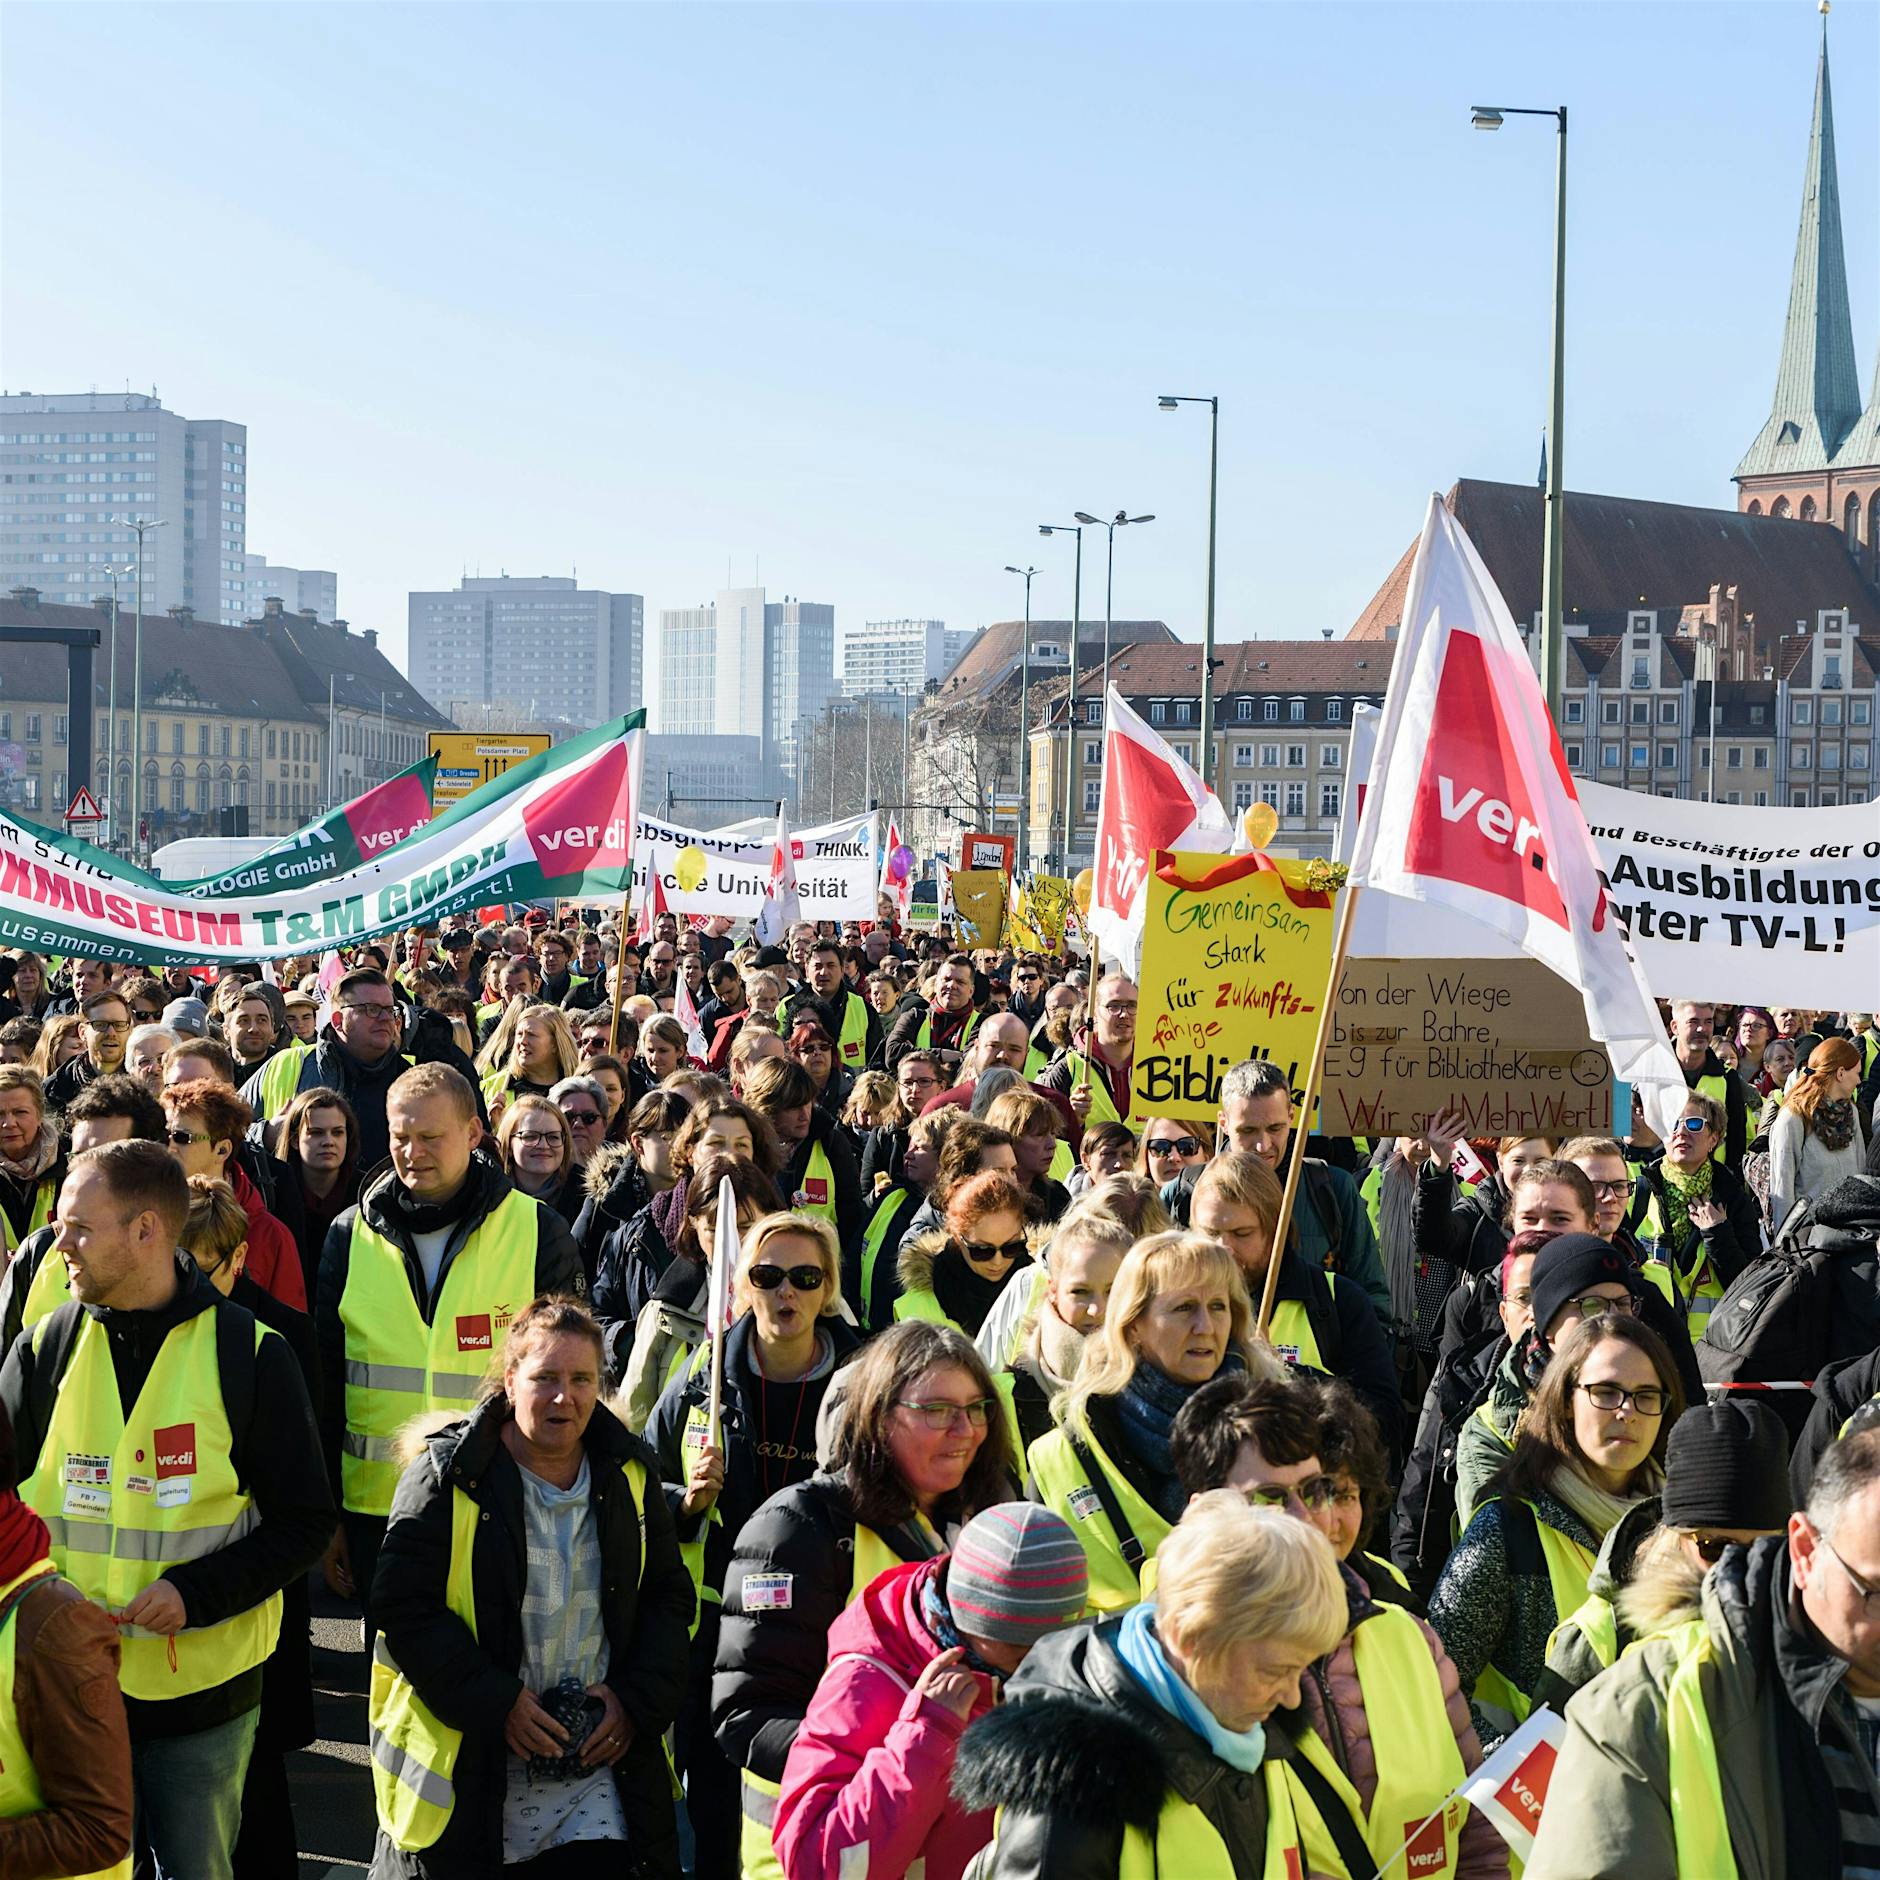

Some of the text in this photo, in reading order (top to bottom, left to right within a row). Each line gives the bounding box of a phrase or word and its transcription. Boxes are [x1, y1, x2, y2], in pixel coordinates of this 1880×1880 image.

[477, 747, 510, 755] Potsdamer
[538, 818, 626, 851] ver.di
[815, 842, 869, 857] THINK.
[1587, 824, 1624, 840] nd
[1632, 829, 1801, 864] Beschäftigte
[1810, 843, 1854, 859] der
[186, 866, 270, 899] OLOGIE
[274, 852, 337, 881] GmbH
[252, 894, 366, 946] T&M
[1164, 888, 1310, 942] Gemeinsam
[1720, 911, 1846, 953] TV-L!
[0, 919, 144, 962] usammen,
[1375, 972, 1417, 1006] der
[1427, 972, 1512, 1013] Wiege
[1333, 1010, 1500, 1049] bis zur Bahre,
[1379, 1046, 1421, 1078] für
[1338, 1088, 1400, 1132] Wir
[459, 1335, 490, 1346] ver.di
[157, 1451, 193, 1467] ver.di
[756, 1441, 799, 1460] GOLD
[1409, 1846, 1445, 1868] ver.di
